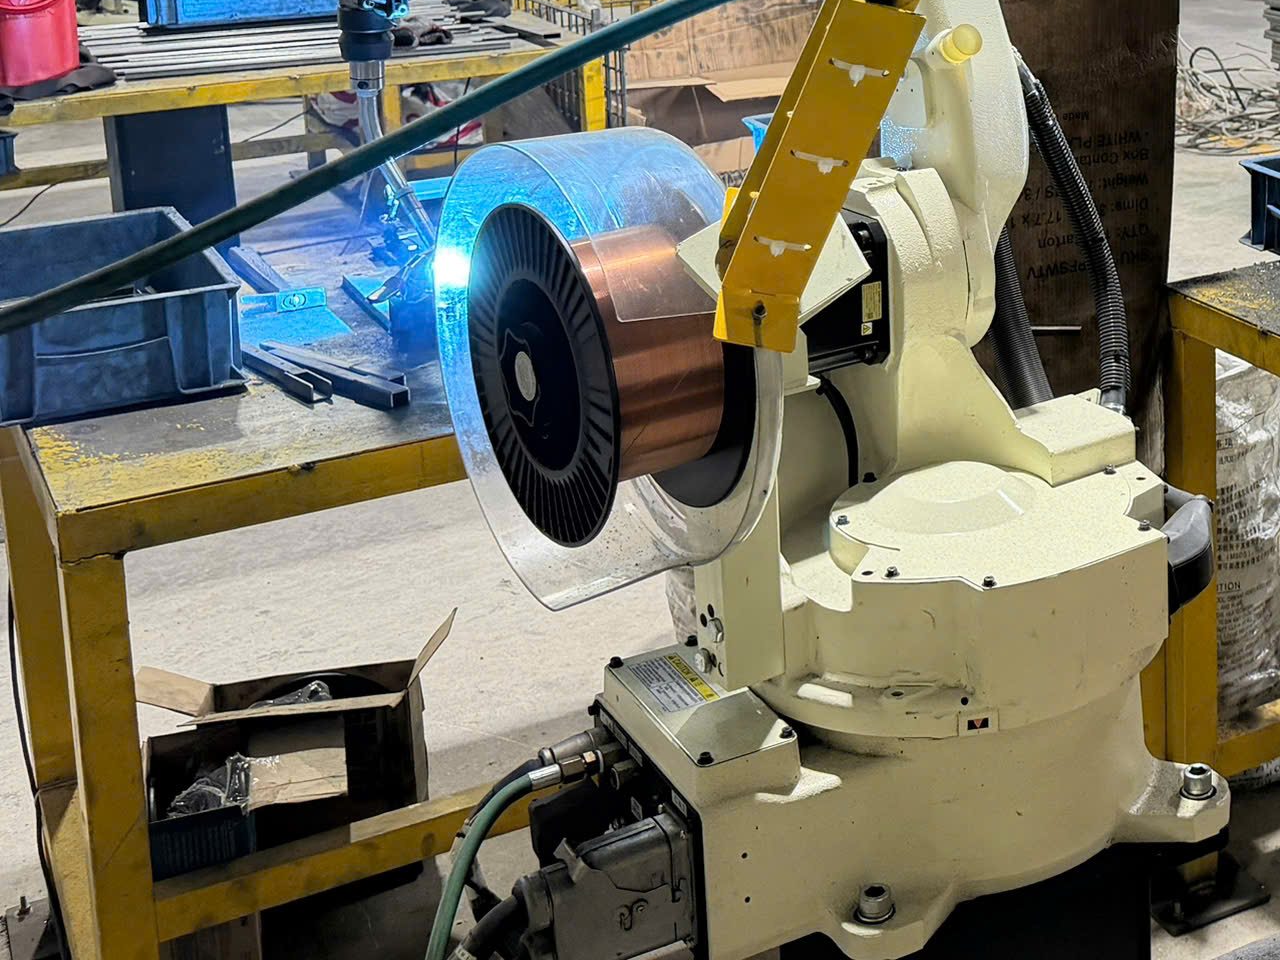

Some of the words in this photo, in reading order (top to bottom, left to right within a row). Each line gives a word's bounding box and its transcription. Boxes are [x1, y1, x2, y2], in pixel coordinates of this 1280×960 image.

[1097, 131, 1141, 147] WHITE
[1123, 148, 1149, 161] Box
[1038, 235, 1076, 249] arton
